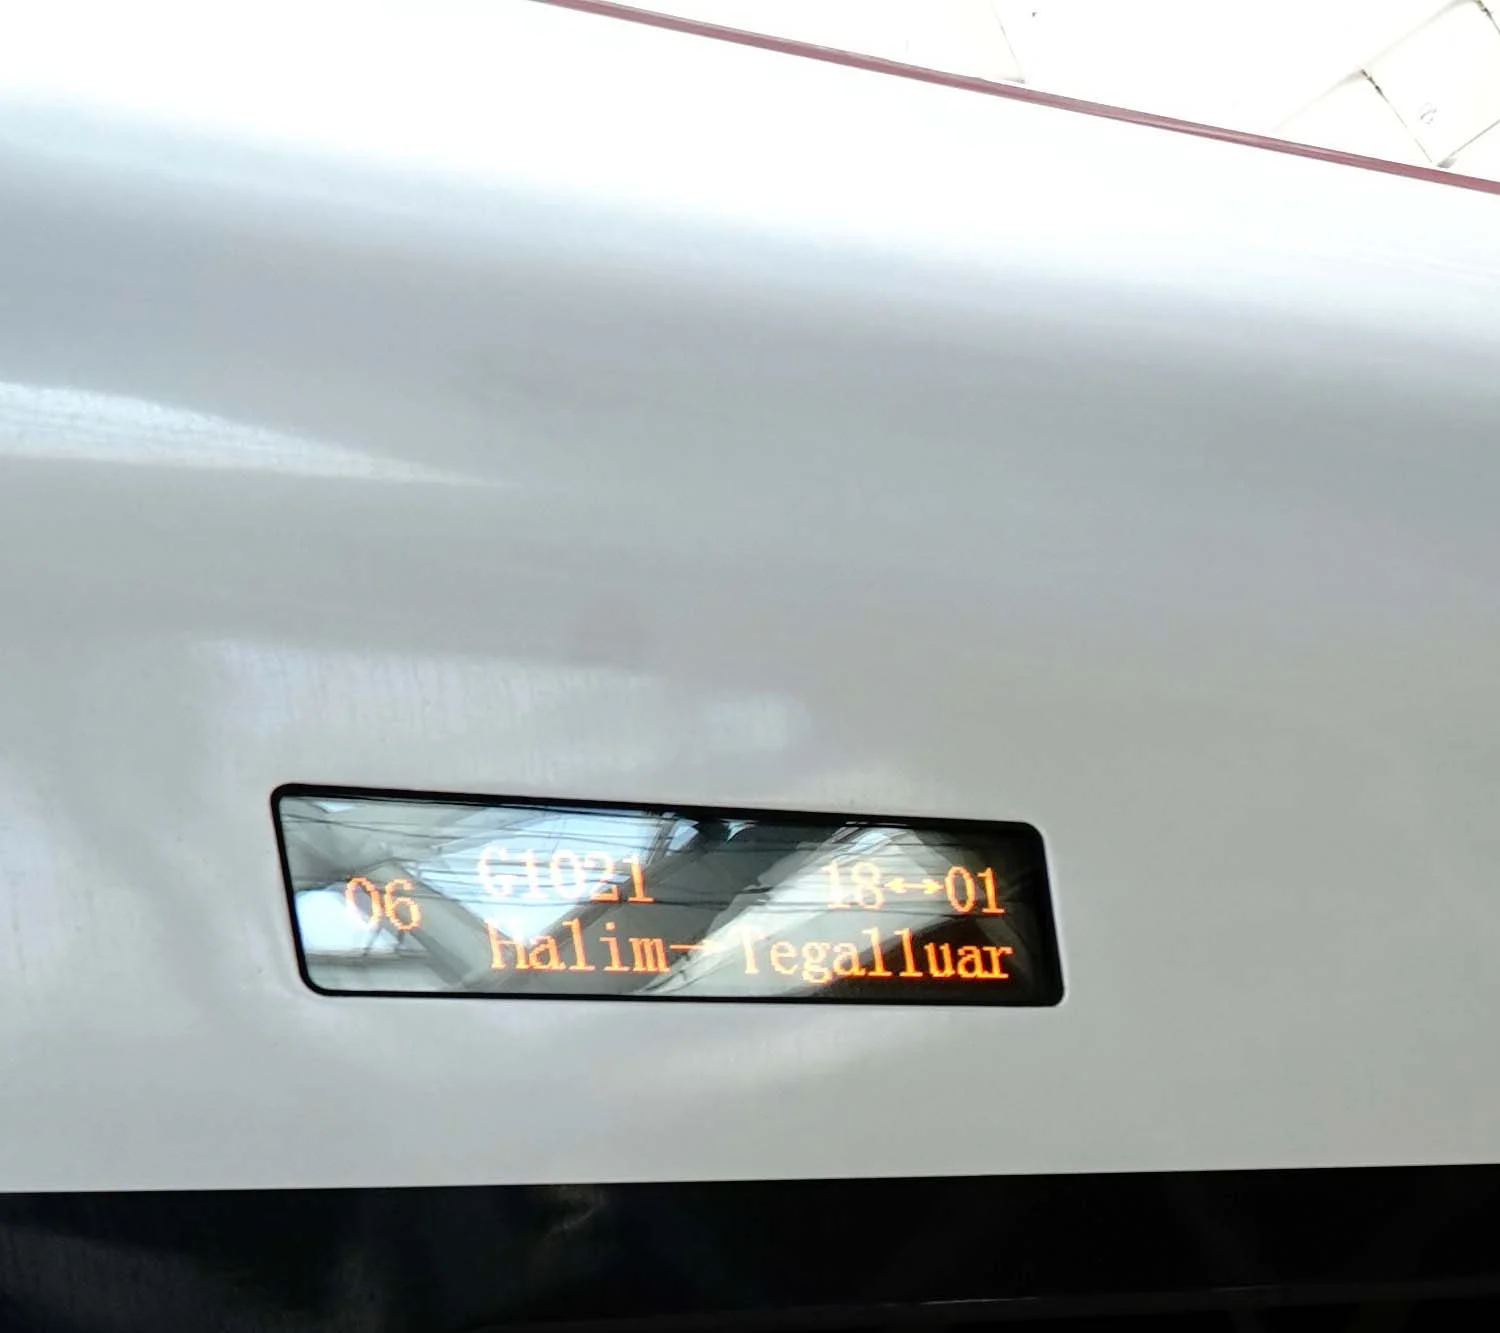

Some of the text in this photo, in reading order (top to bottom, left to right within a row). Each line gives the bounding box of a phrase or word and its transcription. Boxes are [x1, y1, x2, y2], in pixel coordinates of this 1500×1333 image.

[344, 876, 422, 931] 06
[477, 846, 1006, 915] G1021 18 01
[484, 916, 1014, 985] Halim Tegalluar
